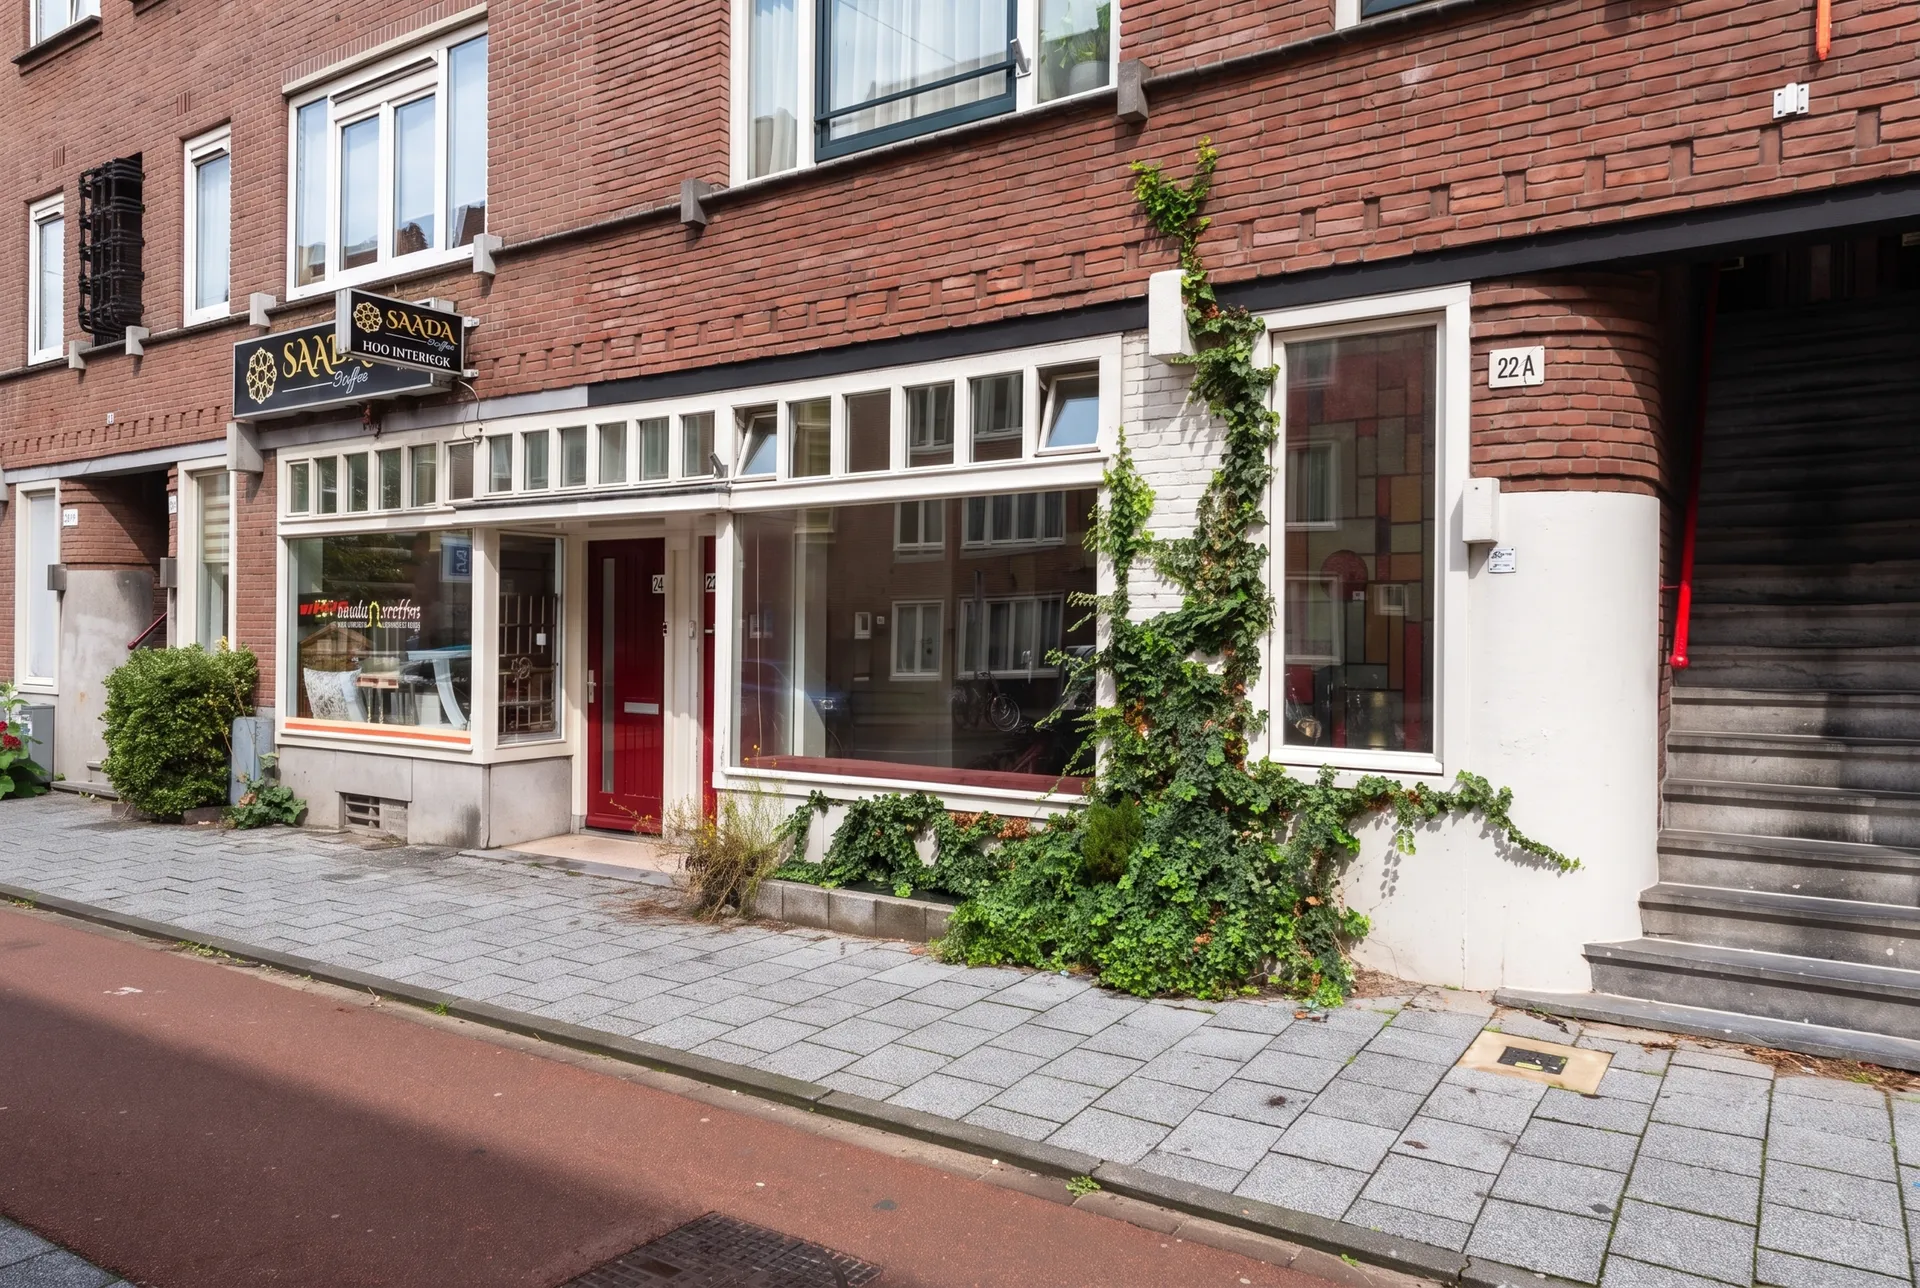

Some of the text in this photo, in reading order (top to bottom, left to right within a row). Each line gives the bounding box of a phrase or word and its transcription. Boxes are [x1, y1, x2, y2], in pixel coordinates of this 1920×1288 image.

[386, 309, 458, 346] SAADA
[363, 340, 390, 355] HOO
[653, 576, 664, 592] 24
